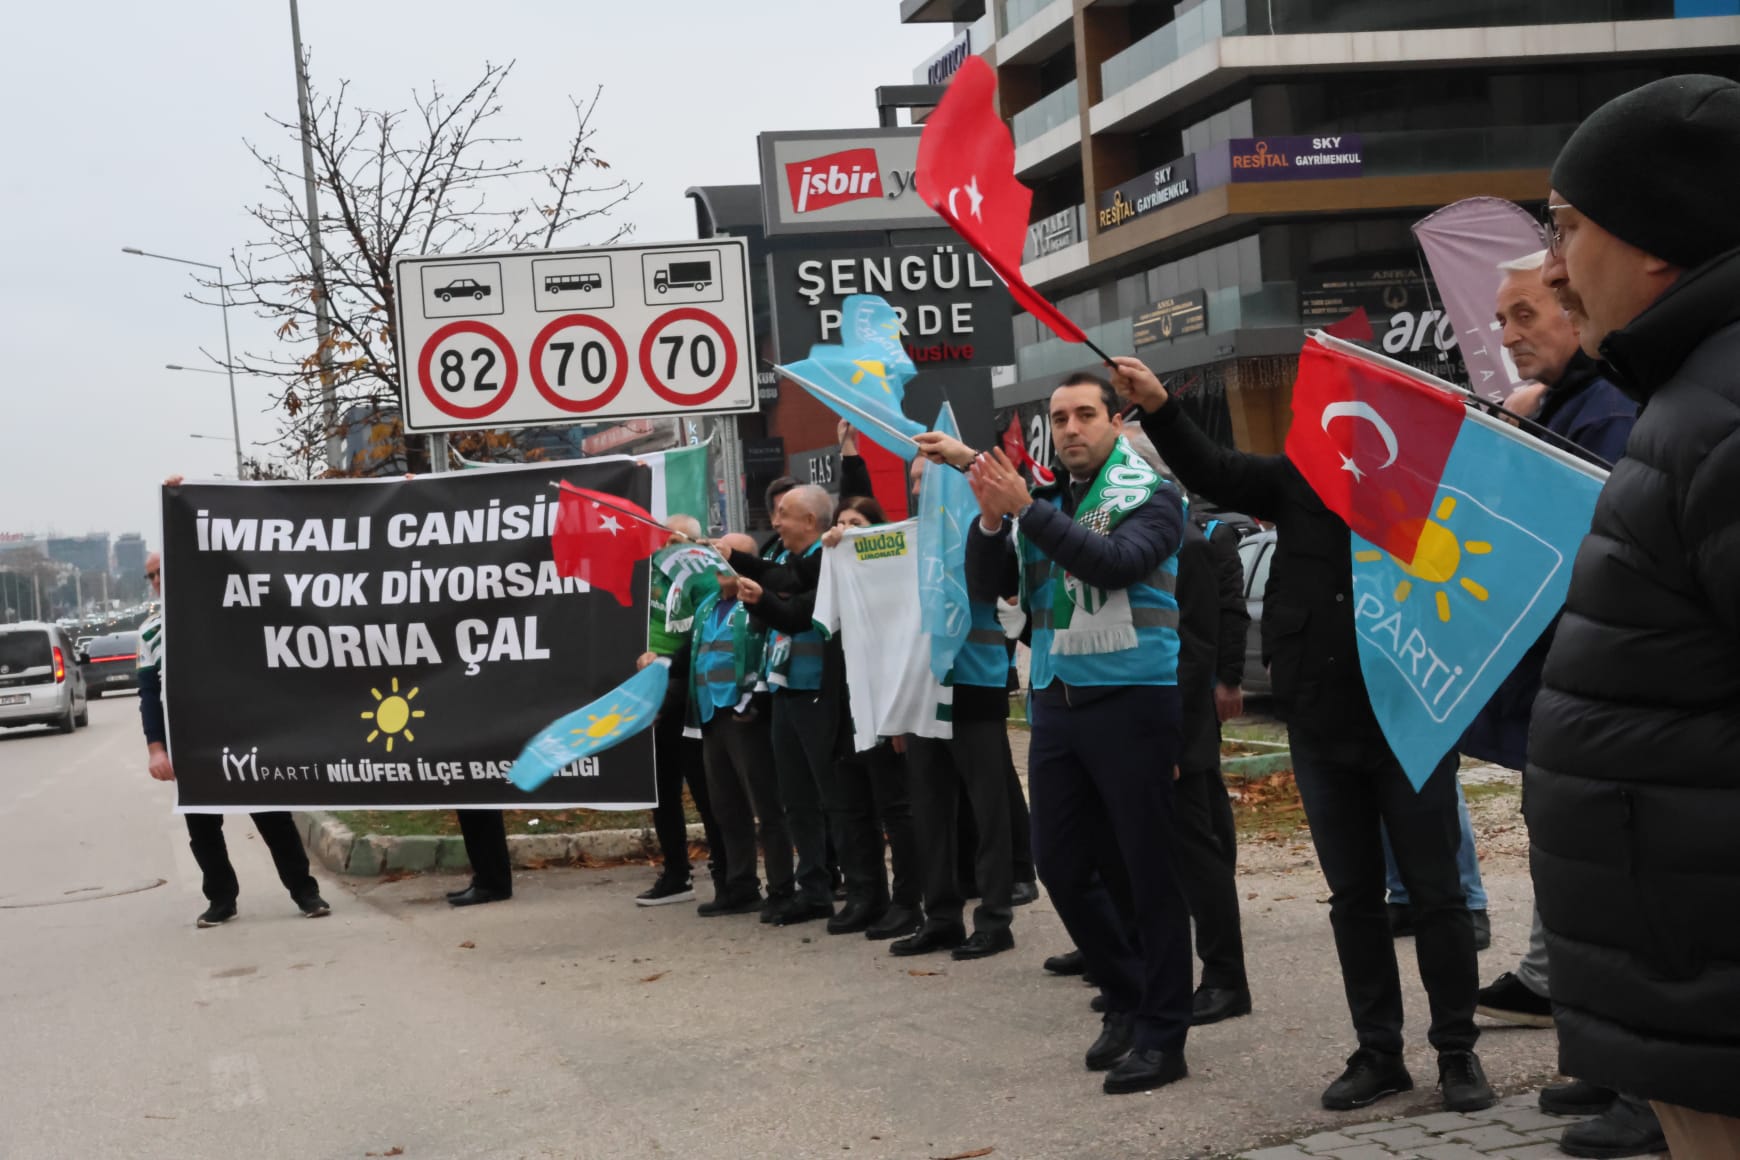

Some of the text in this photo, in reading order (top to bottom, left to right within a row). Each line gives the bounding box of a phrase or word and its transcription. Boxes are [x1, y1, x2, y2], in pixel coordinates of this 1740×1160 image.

[1295, 153, 1361, 166] GAYRİMENKUL
[1312, 137, 1341, 149] SKY
[1154, 166, 1171, 186] SKY
[1137, 180, 1189, 213] GAYRİMENKUL
[798, 246, 993, 305] ŞENGÜL
[820, 303, 975, 340] PRDE
[440, 348, 498, 392] 82
[550, 341, 607, 386] 70
[659, 334, 716, 380] 70
[809, 455, 832, 485] HAS
[196, 509, 370, 551] İMRALI
[223, 558, 590, 608] AF YOK DİYORSAN
[264, 616, 550, 676] KORNA ÇAL
[260, 763, 319, 781] PARTİ
[327, 758, 411, 783] NİLÜFER
[417, 757, 465, 784] İLÇE
